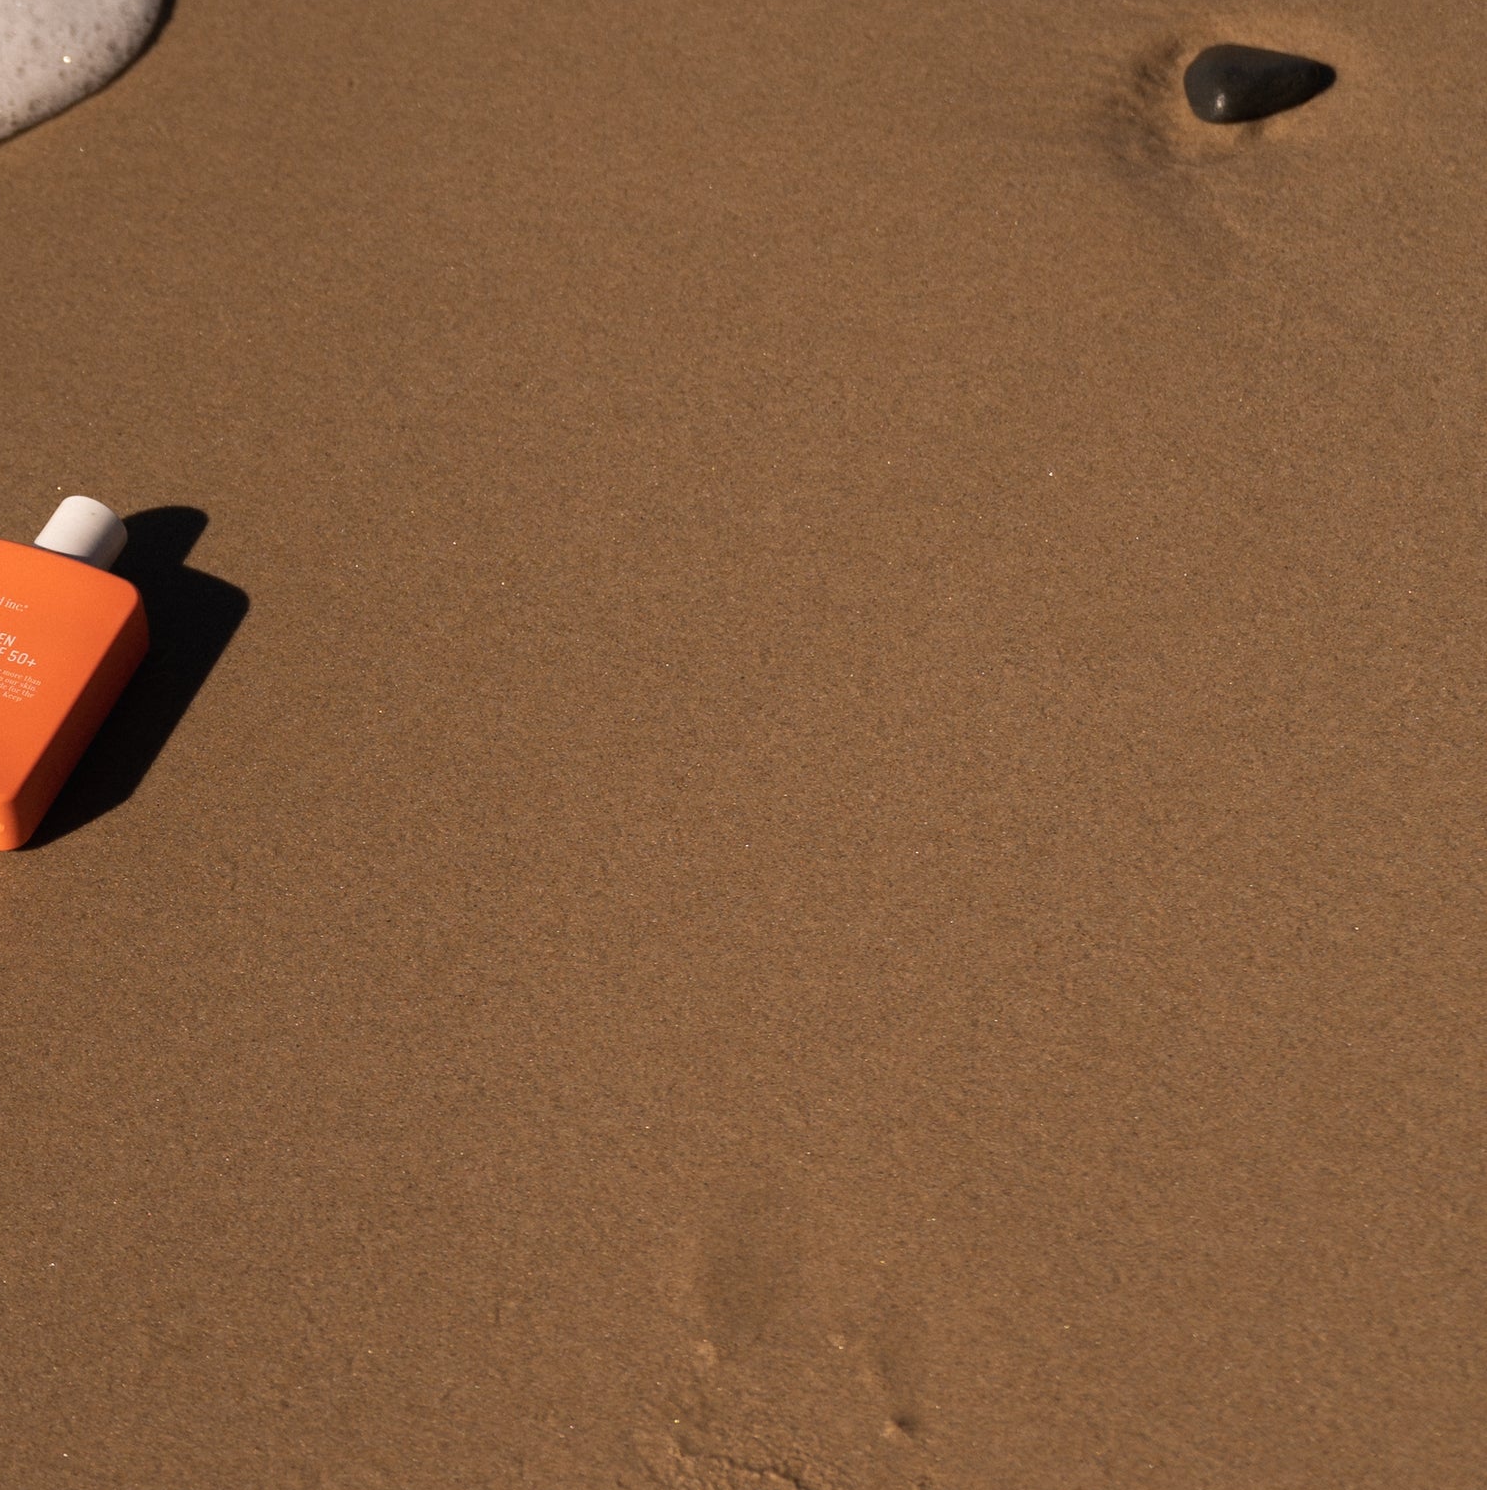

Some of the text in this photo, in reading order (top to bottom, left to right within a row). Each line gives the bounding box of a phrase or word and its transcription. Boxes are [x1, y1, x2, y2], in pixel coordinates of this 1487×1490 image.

[7, 650, 36, 667] 50+
[24, 676, 41, 686] than
[2, 691, 22, 702] Keep
[8, 685, 21, 693] for
[21, 690, 34, 698] the
